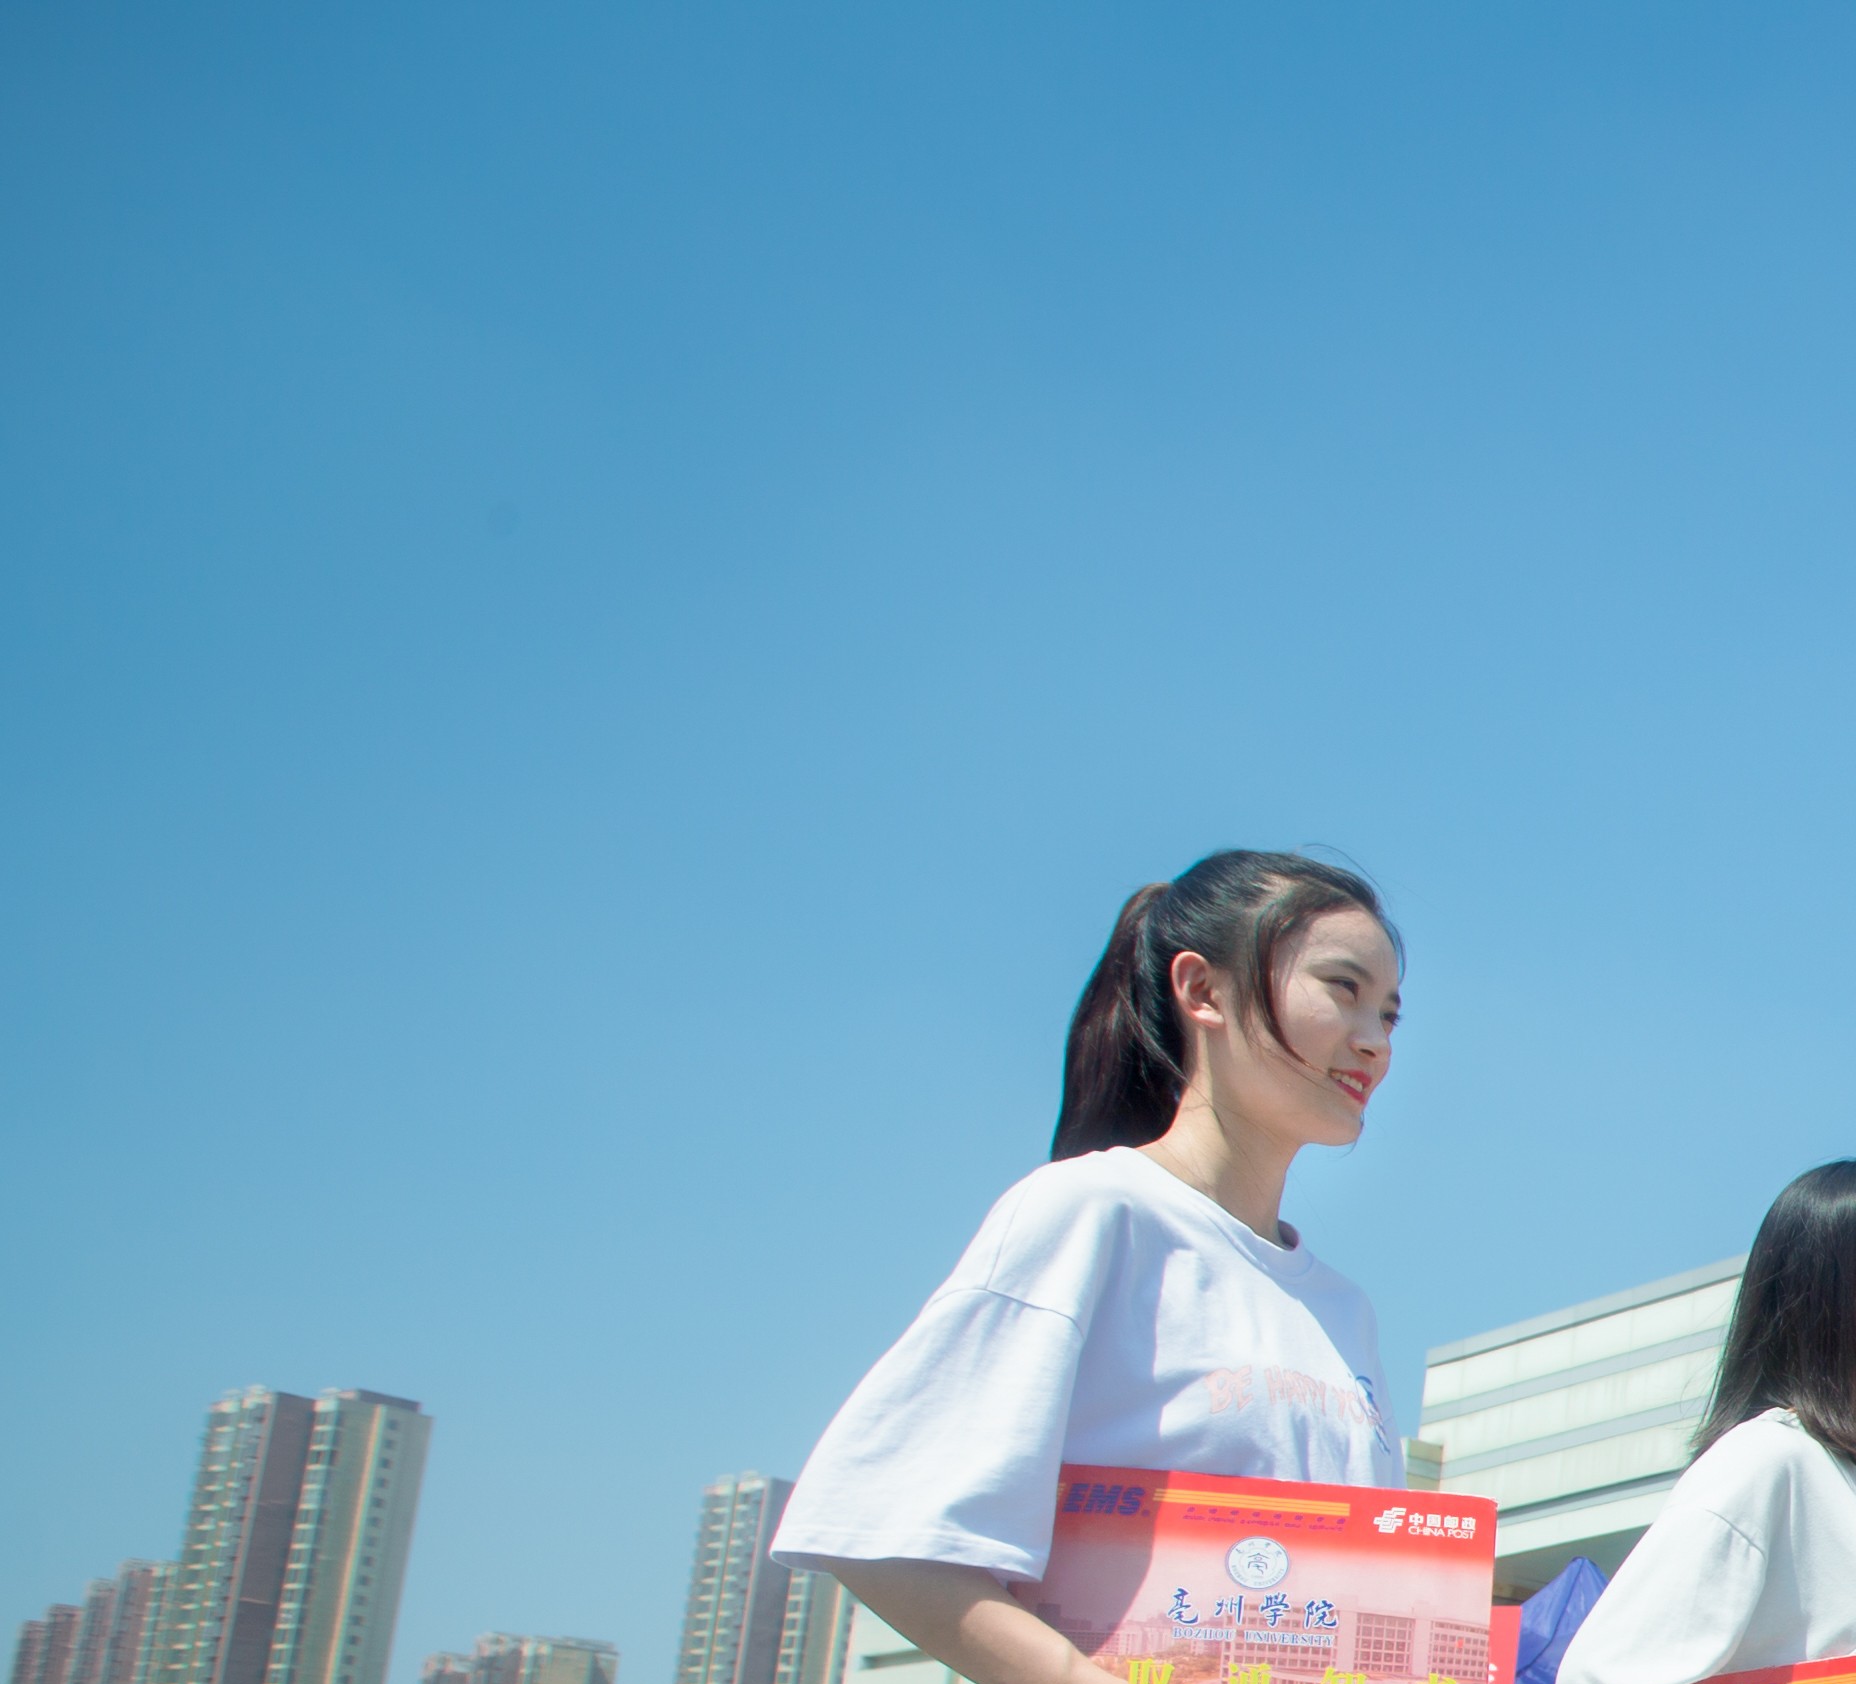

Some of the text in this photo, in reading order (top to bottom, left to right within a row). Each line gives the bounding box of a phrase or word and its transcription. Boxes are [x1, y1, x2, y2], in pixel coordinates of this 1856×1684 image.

[1204, 1364, 1252, 1414] BE
[1063, 1482, 1147, 1518] EMS
[1408, 1512, 1476, 1531] 中国邮政
[1408, 1526, 1475, 1540] CHINA POST
[1172, 1626, 1336, 1647] BOZHOU UNIVERSITY
